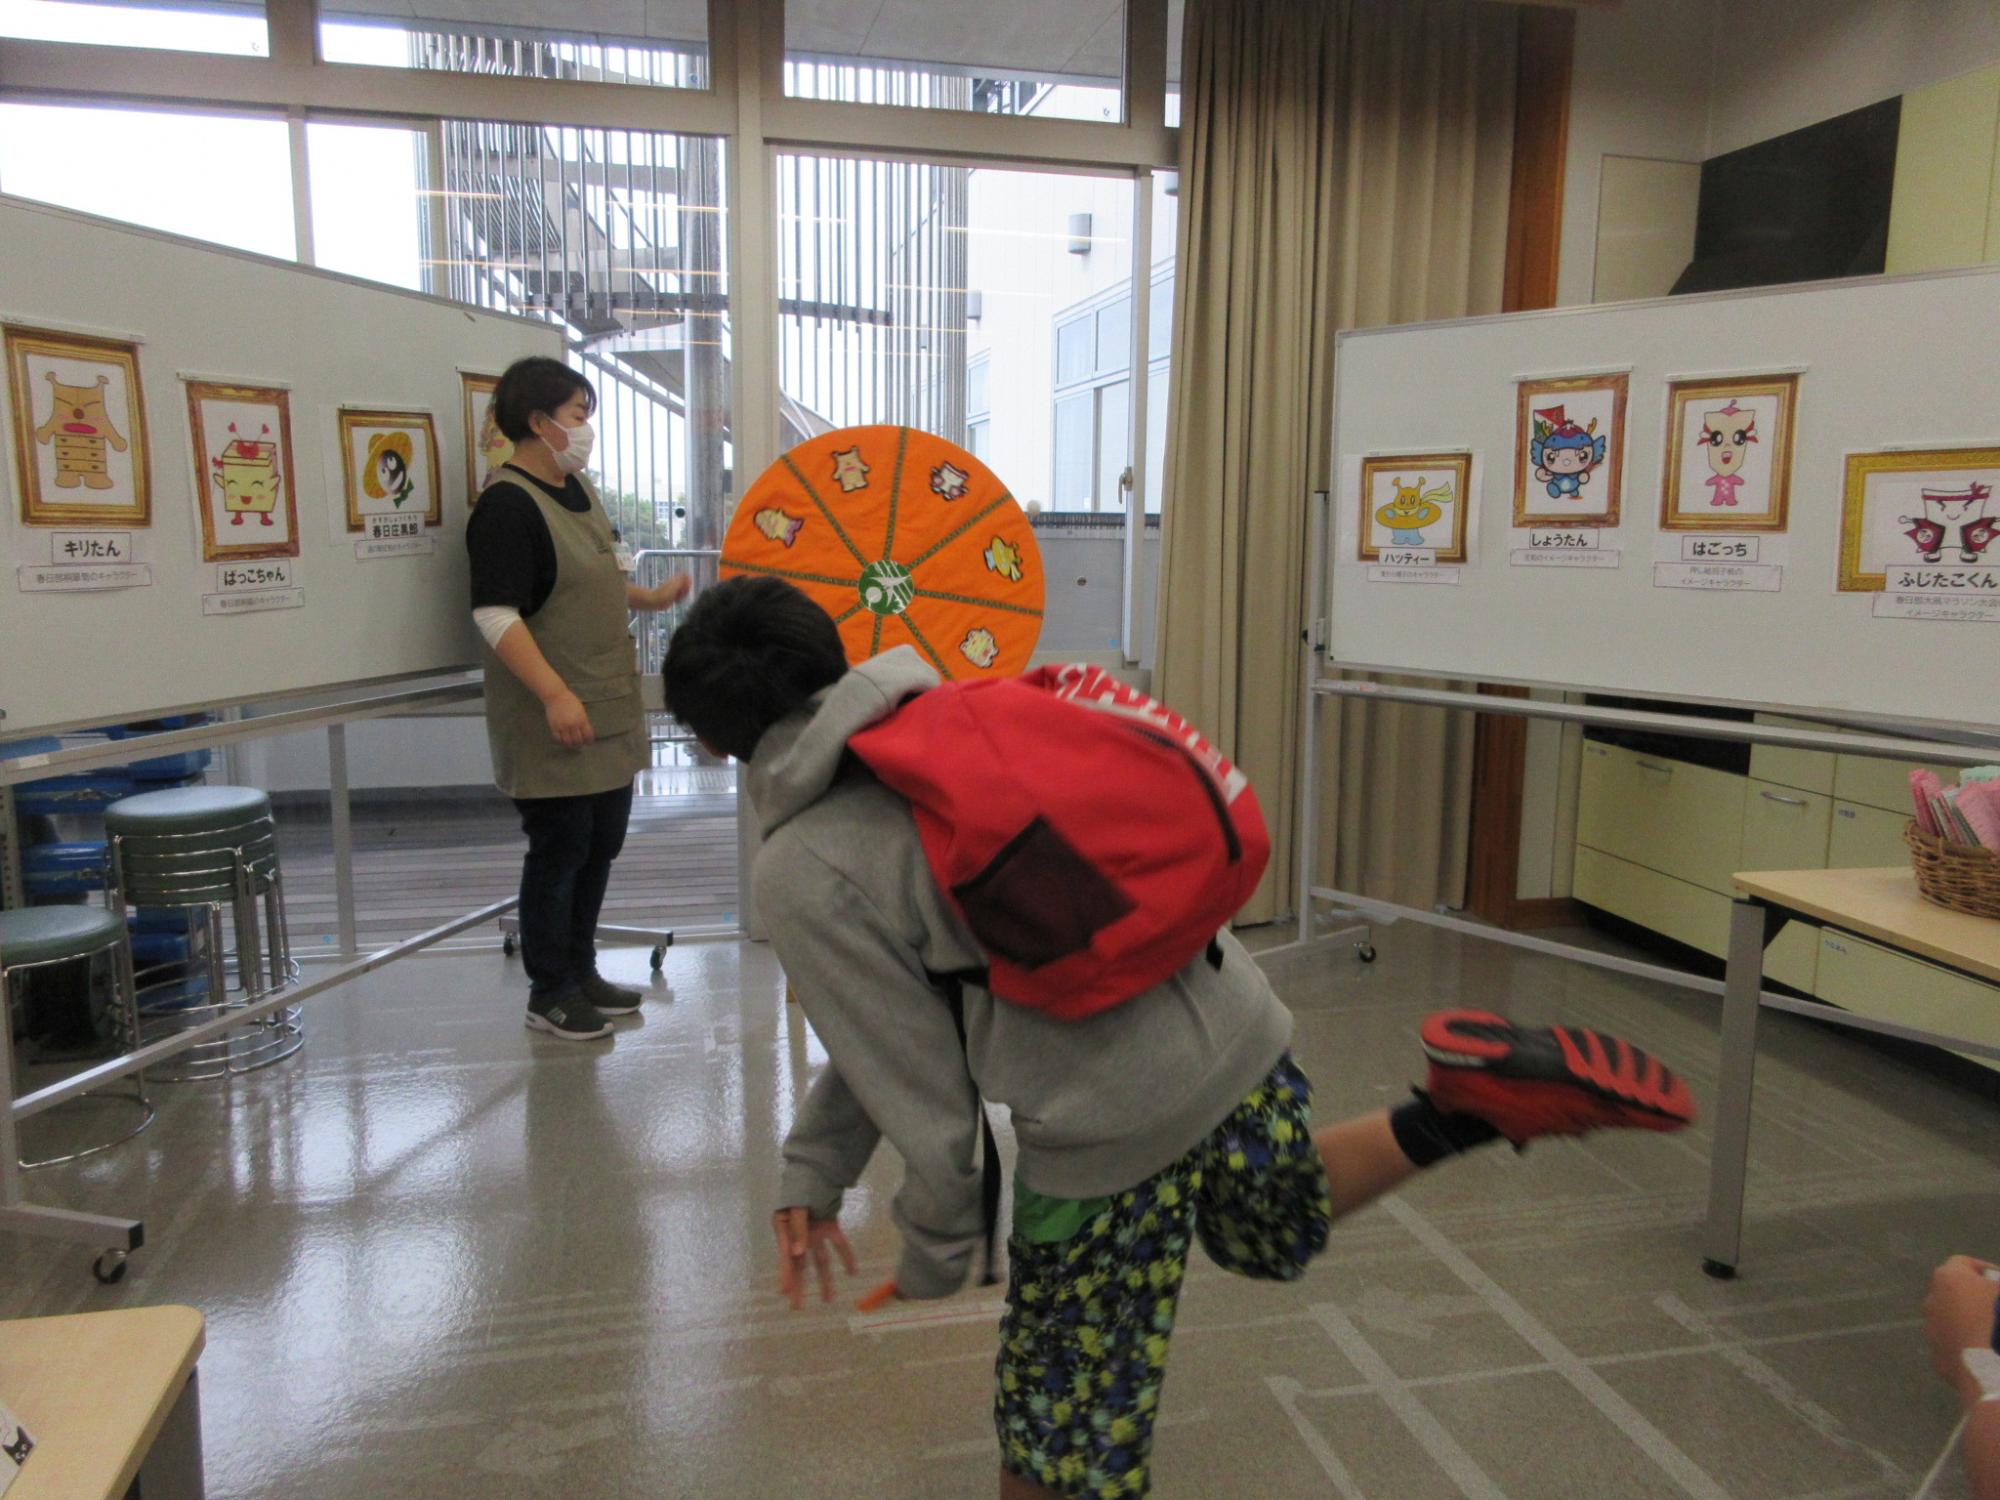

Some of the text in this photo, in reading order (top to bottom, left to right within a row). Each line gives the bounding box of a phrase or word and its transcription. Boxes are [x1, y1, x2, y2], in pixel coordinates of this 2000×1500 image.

[1531, 533, 1588, 547] しょうたん
[65, 540, 121, 557] キリたん
[1693, 542, 1748, 557] はごっち
[1385, 553, 1430, 565] ハッティー
[1898, 572, 1998, 588] ふじたこくん
